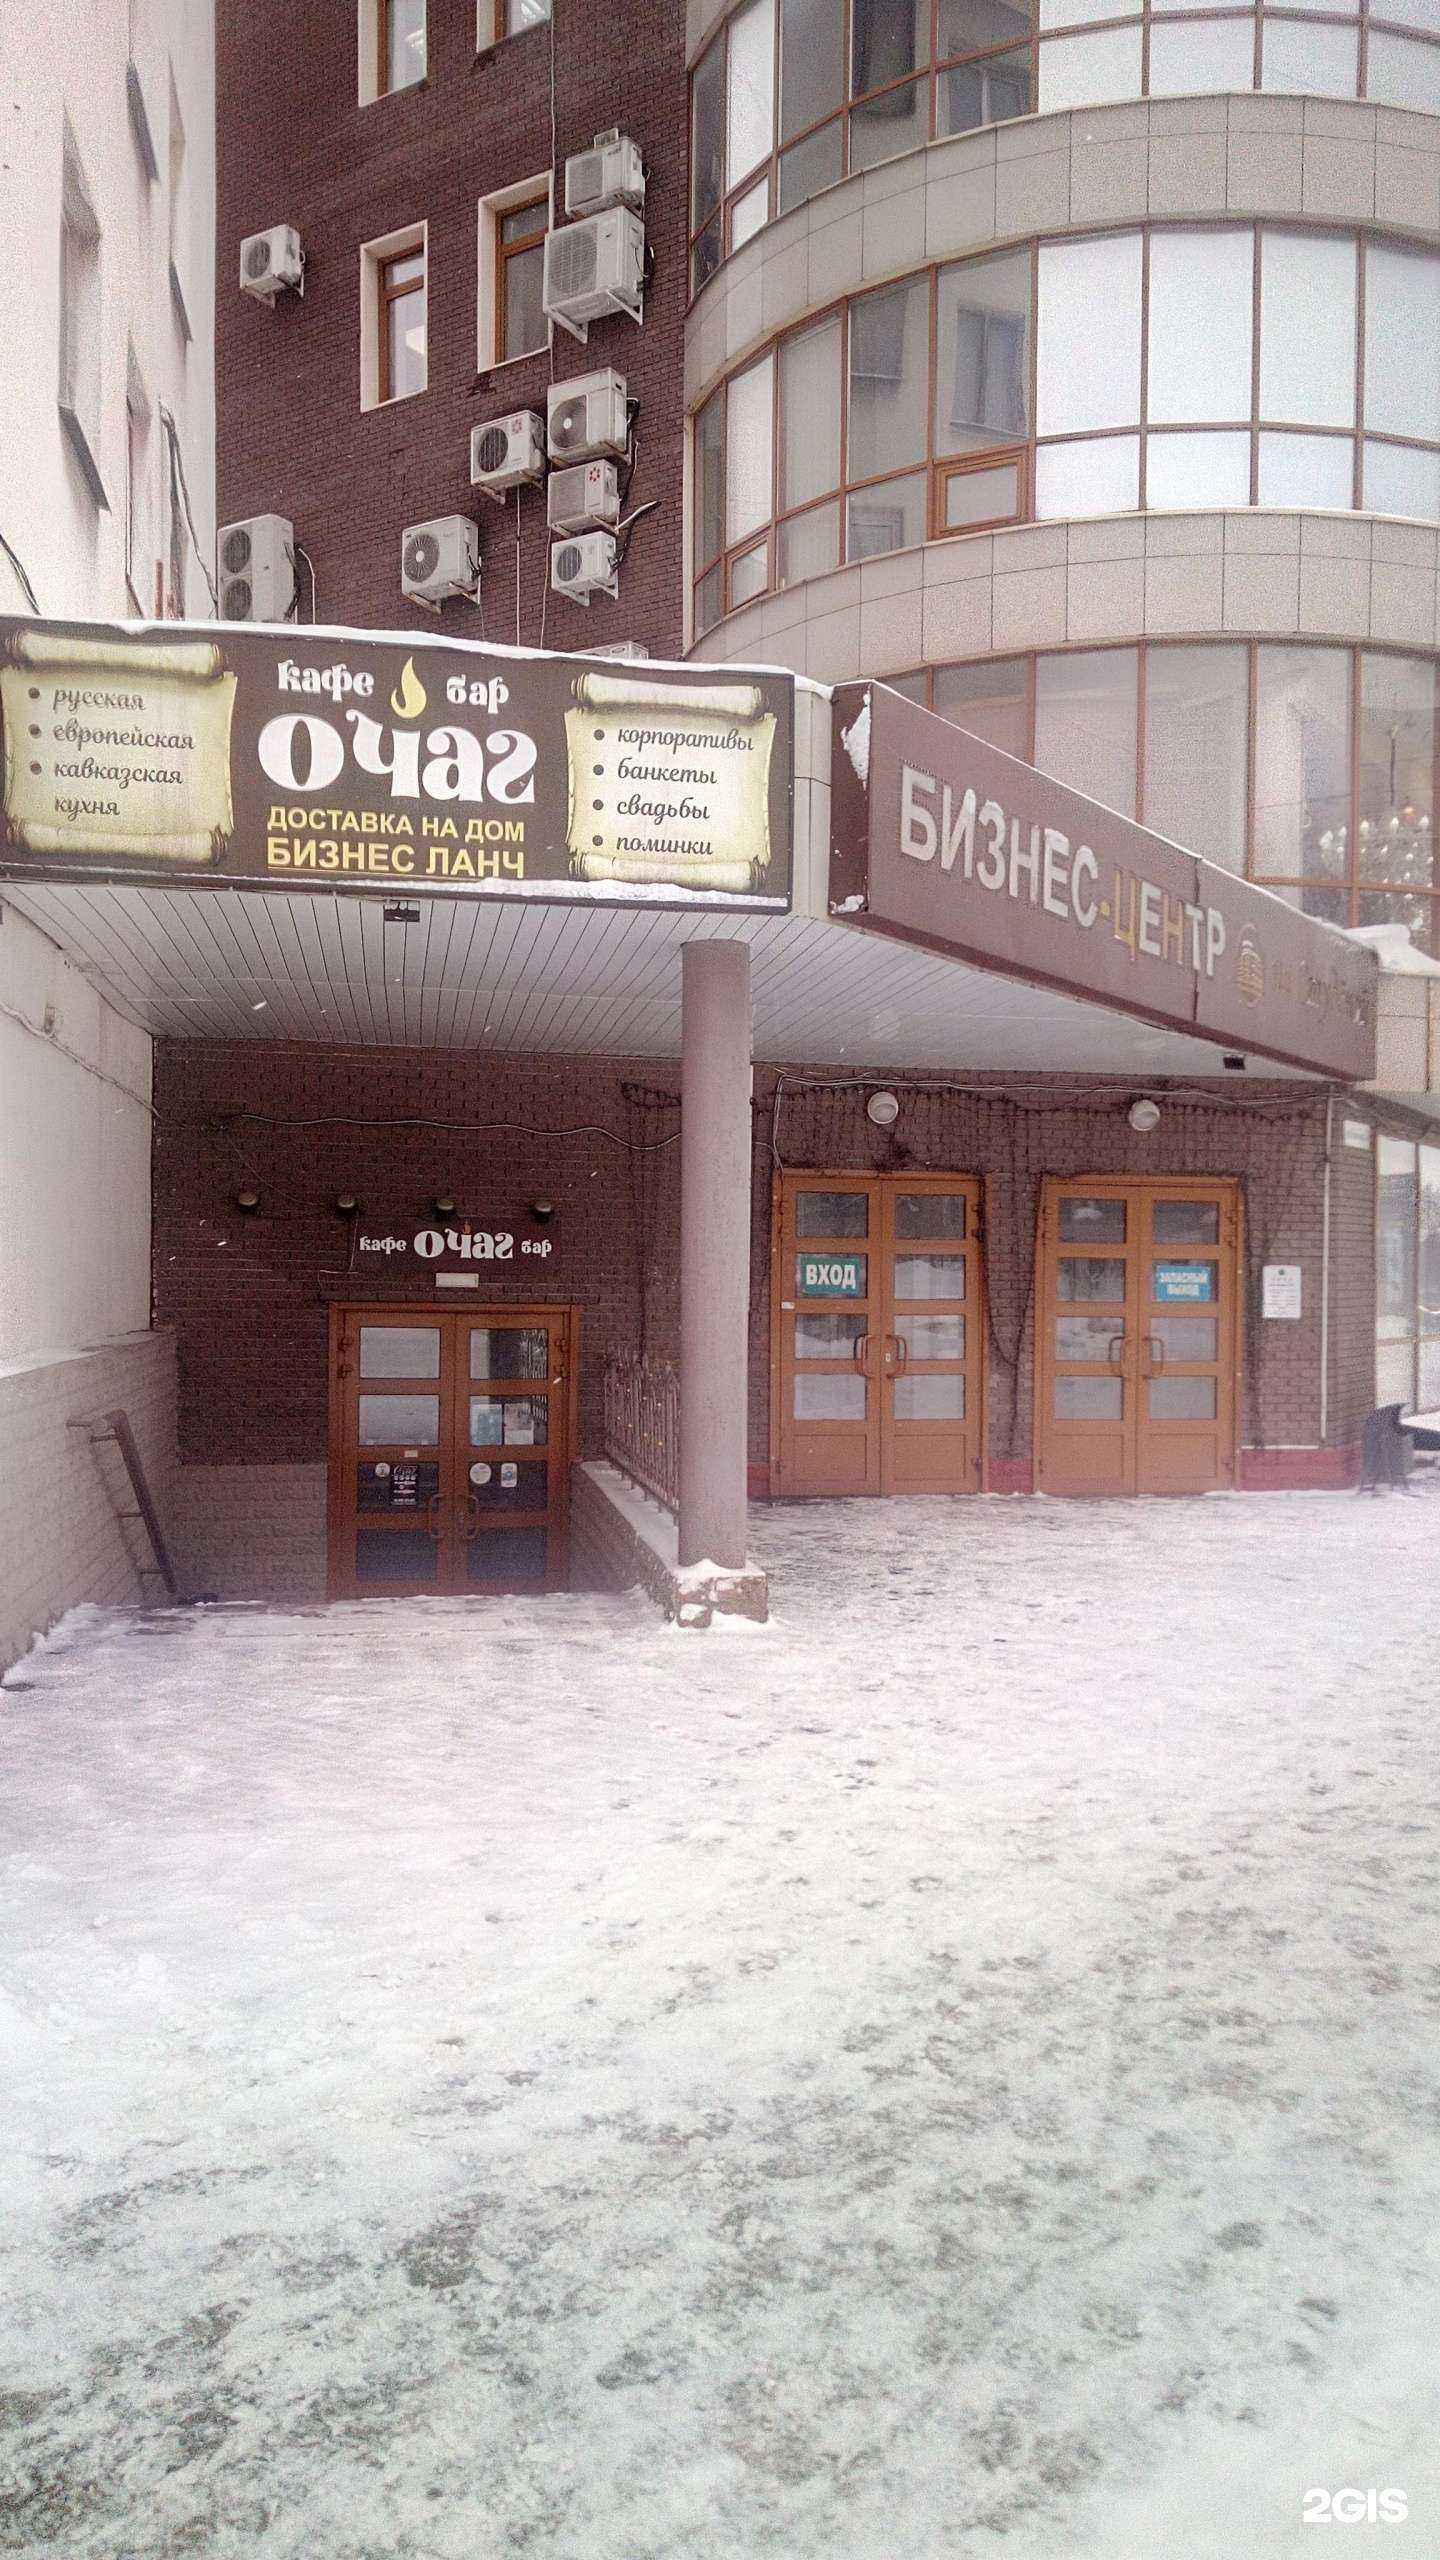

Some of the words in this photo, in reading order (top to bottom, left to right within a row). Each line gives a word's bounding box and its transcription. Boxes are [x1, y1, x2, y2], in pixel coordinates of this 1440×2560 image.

[53, 686, 145, 710] русская
[277, 659, 374, 701] кафе
[446, 674, 509, 715] бар
[54, 721, 195, 752] европейская
[617, 727, 754, 755] корпоративы
[54, 757, 183, 789] кавказская
[617, 757, 718, 785] банкеты
[54, 796, 121, 819] кухня
[616, 793, 710, 825] свадьбы
[267, 805, 415, 835] ДОСТАВКА
[422, 817, 459, 838] НА
[464, 819, 525, 842] ДОМ
[267, 837, 416, 872] БИЗНЕС
[425, 846, 525, 879] ЛАНЧ
[616, 836, 714, 857] поминки
[359, 1235, 407, 1255] кафе
[520, 1238, 552, 1258] бар
[806, 1264, 856, 1290] ВХОД
